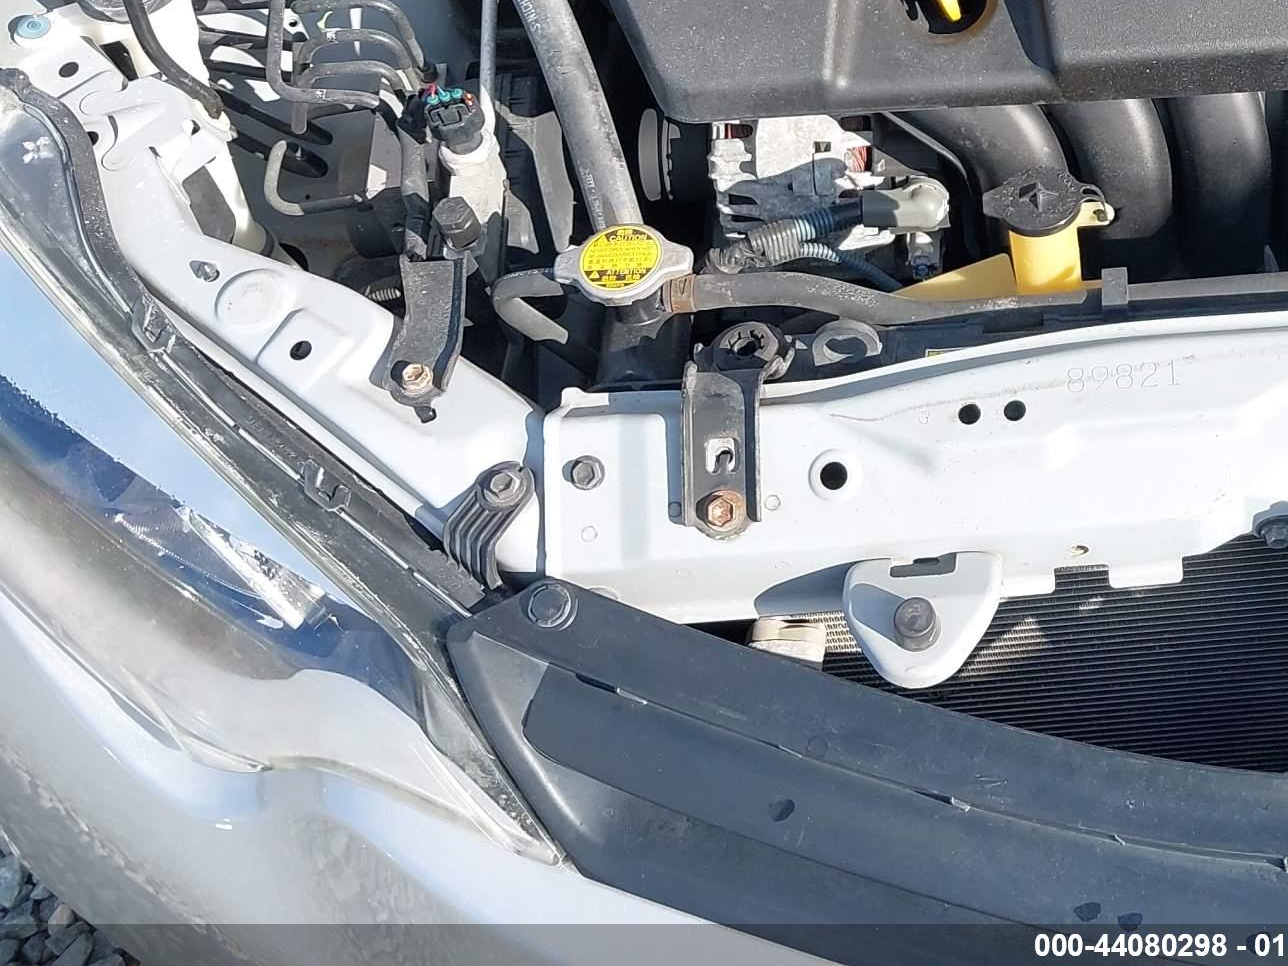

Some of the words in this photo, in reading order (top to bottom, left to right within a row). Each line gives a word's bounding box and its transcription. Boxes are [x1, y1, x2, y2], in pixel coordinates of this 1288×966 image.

[609, 234, 648, 243] CAUTION
[606, 267, 647, 276] ATTENTION
[1067, 359, 1179, 393] 89821
